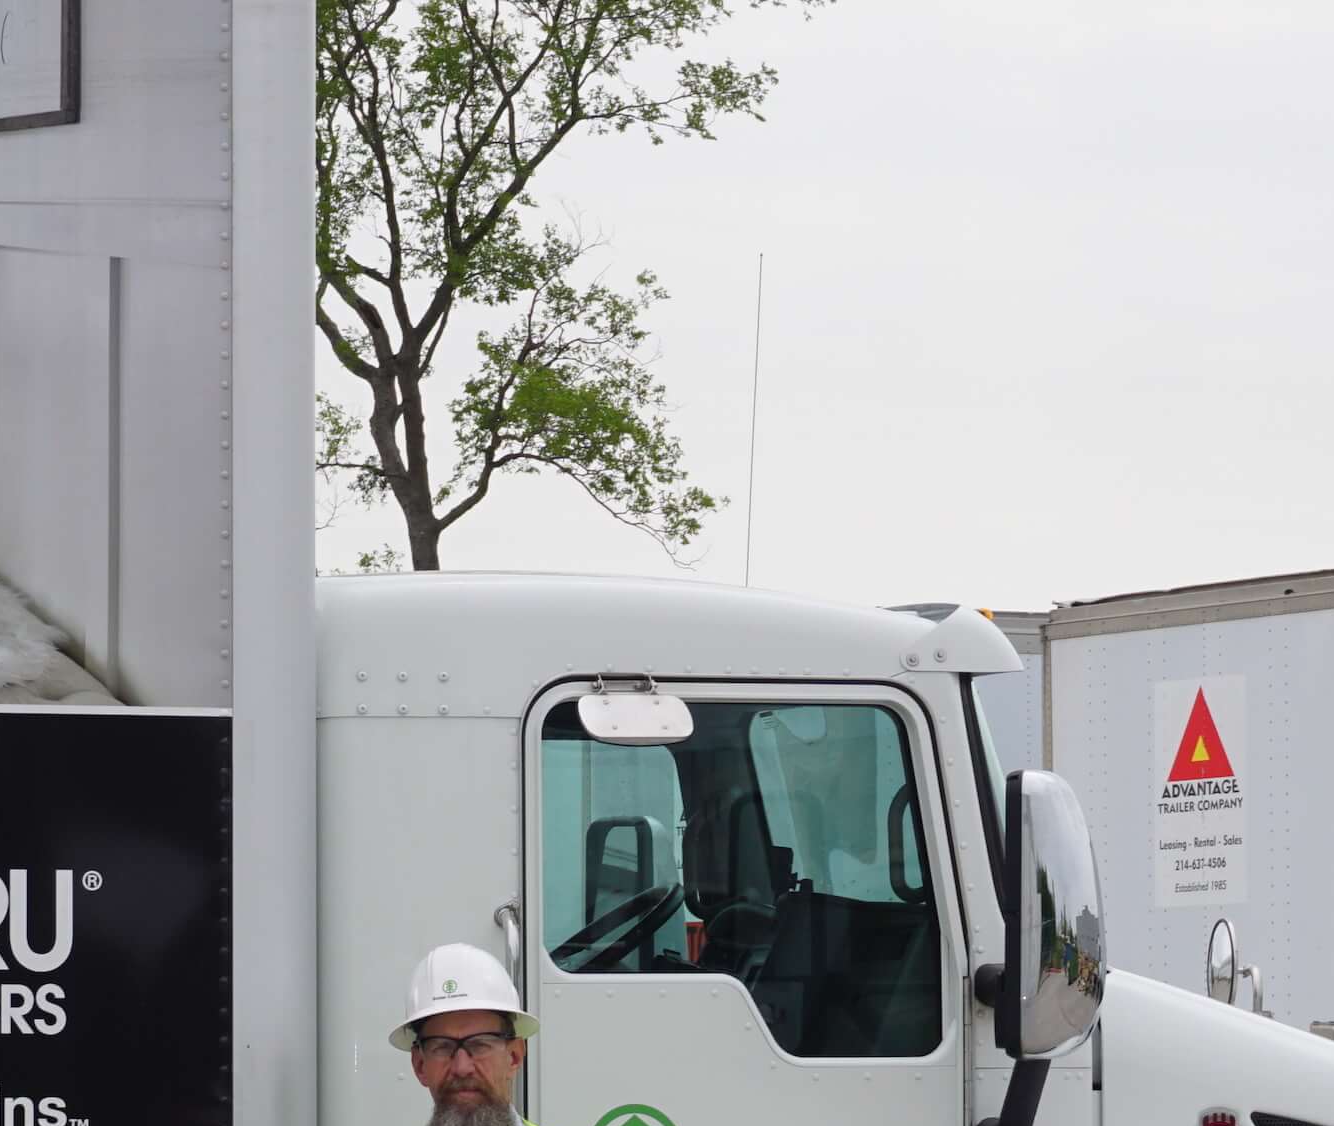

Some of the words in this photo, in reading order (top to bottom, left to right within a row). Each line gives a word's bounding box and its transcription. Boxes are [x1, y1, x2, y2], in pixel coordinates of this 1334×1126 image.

[1162, 779, 1240, 799] ADVANTAGE
[1157, 801, 1195, 815] TRAILER
[1197, 797, 1243, 811] COMPANY
